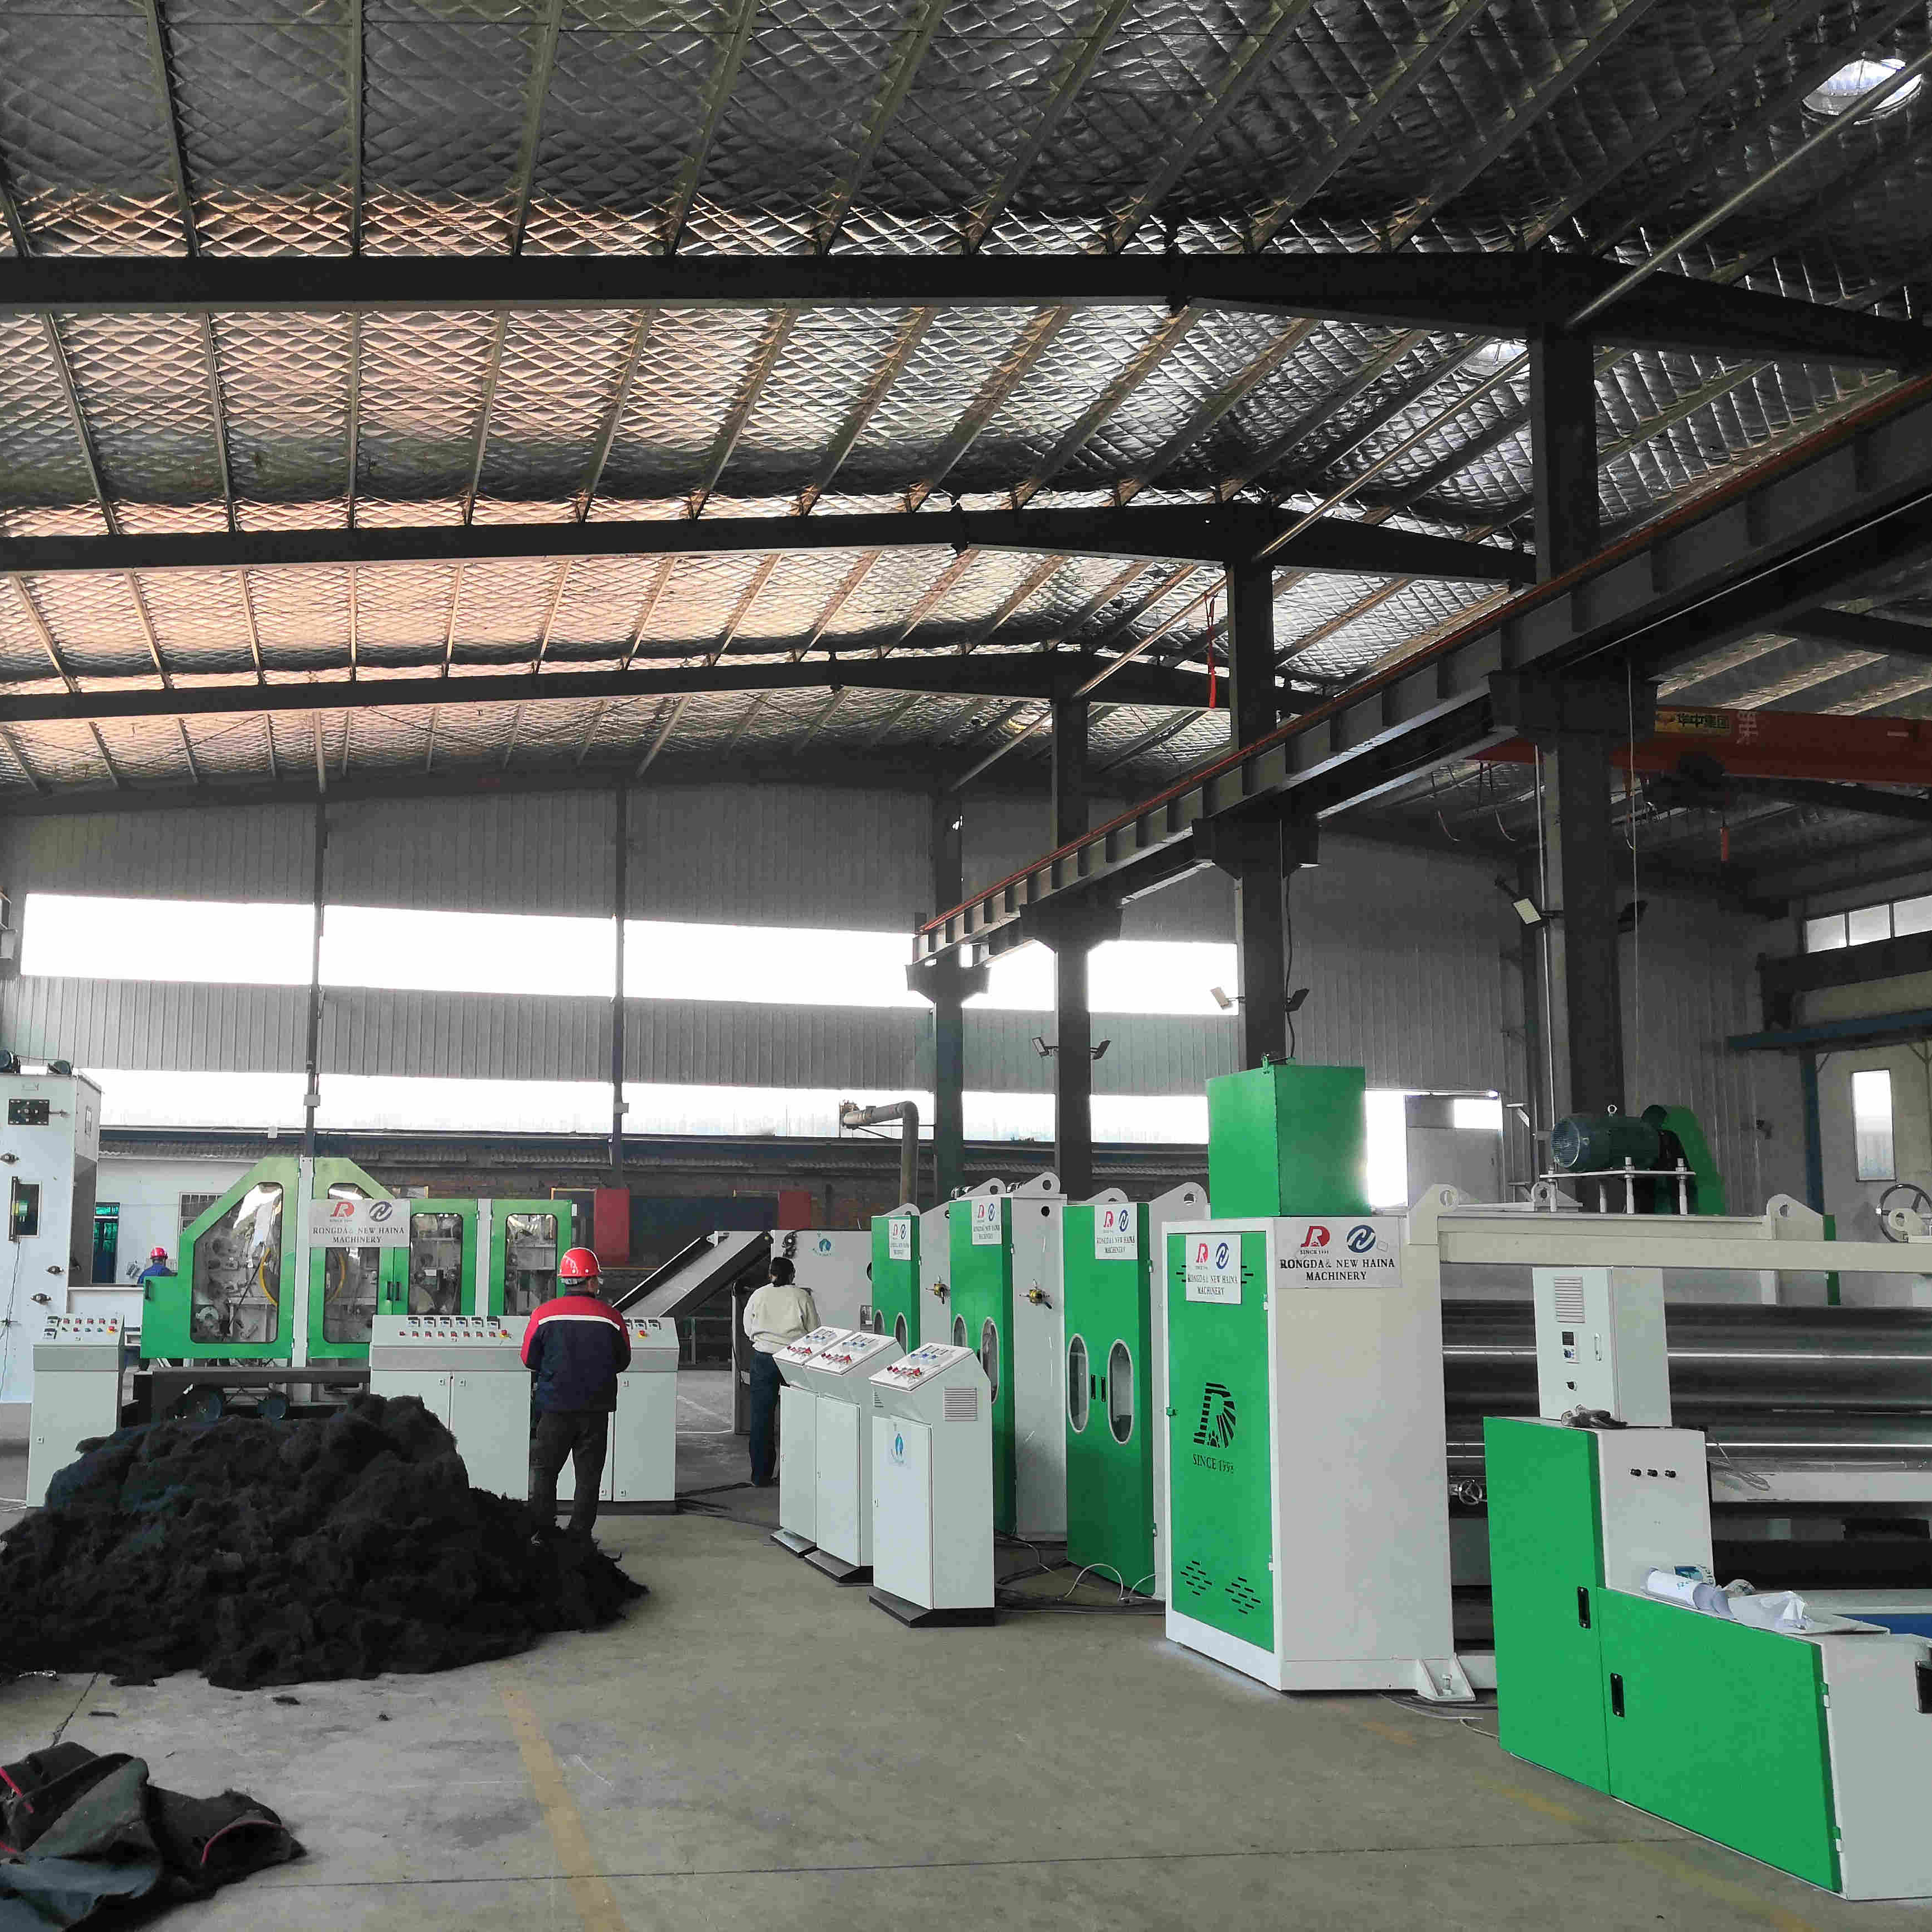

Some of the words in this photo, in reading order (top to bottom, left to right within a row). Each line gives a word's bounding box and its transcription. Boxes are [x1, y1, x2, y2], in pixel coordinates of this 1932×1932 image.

[1336, 1259, 1358, 1268] NEW
[1362, 1258, 1395, 1268] HAINA
[1305, 1271, 1367, 1281] MACHINERY
[1197, 1286, 1225, 1295] MACHINERY
[1193, 1453, 1216, 1470] SINCE
